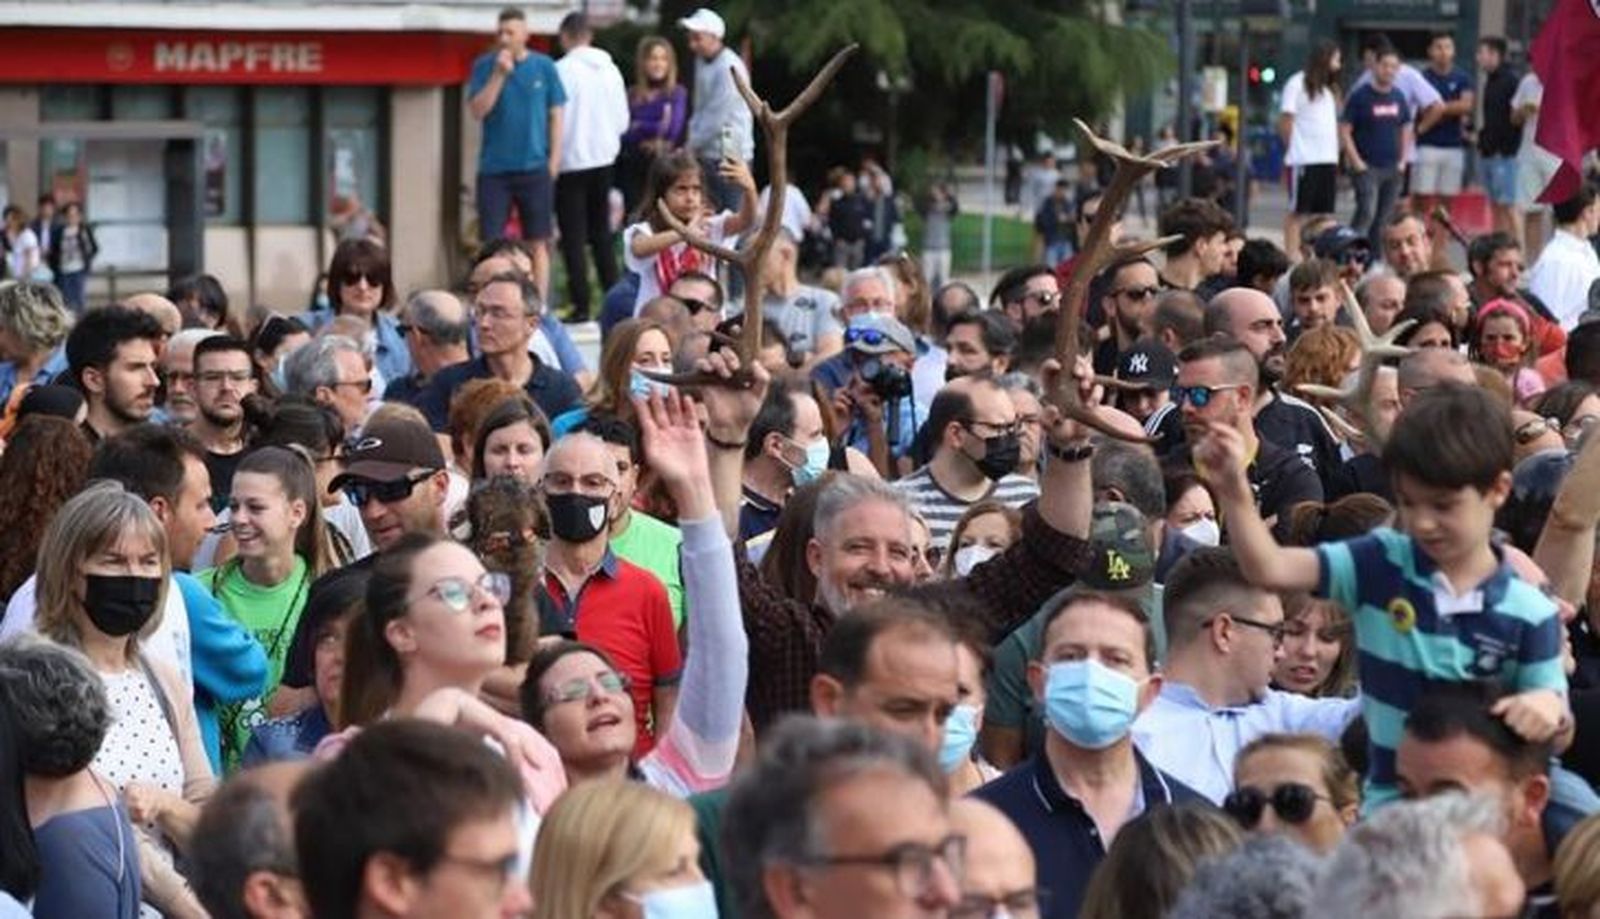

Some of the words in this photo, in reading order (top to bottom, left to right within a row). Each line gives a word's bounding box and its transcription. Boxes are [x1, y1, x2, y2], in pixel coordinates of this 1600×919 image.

[154, 41, 323, 72] MAPFRE
[1129, 353, 1148, 372] NY
[1107, 550, 1130, 579] LA
